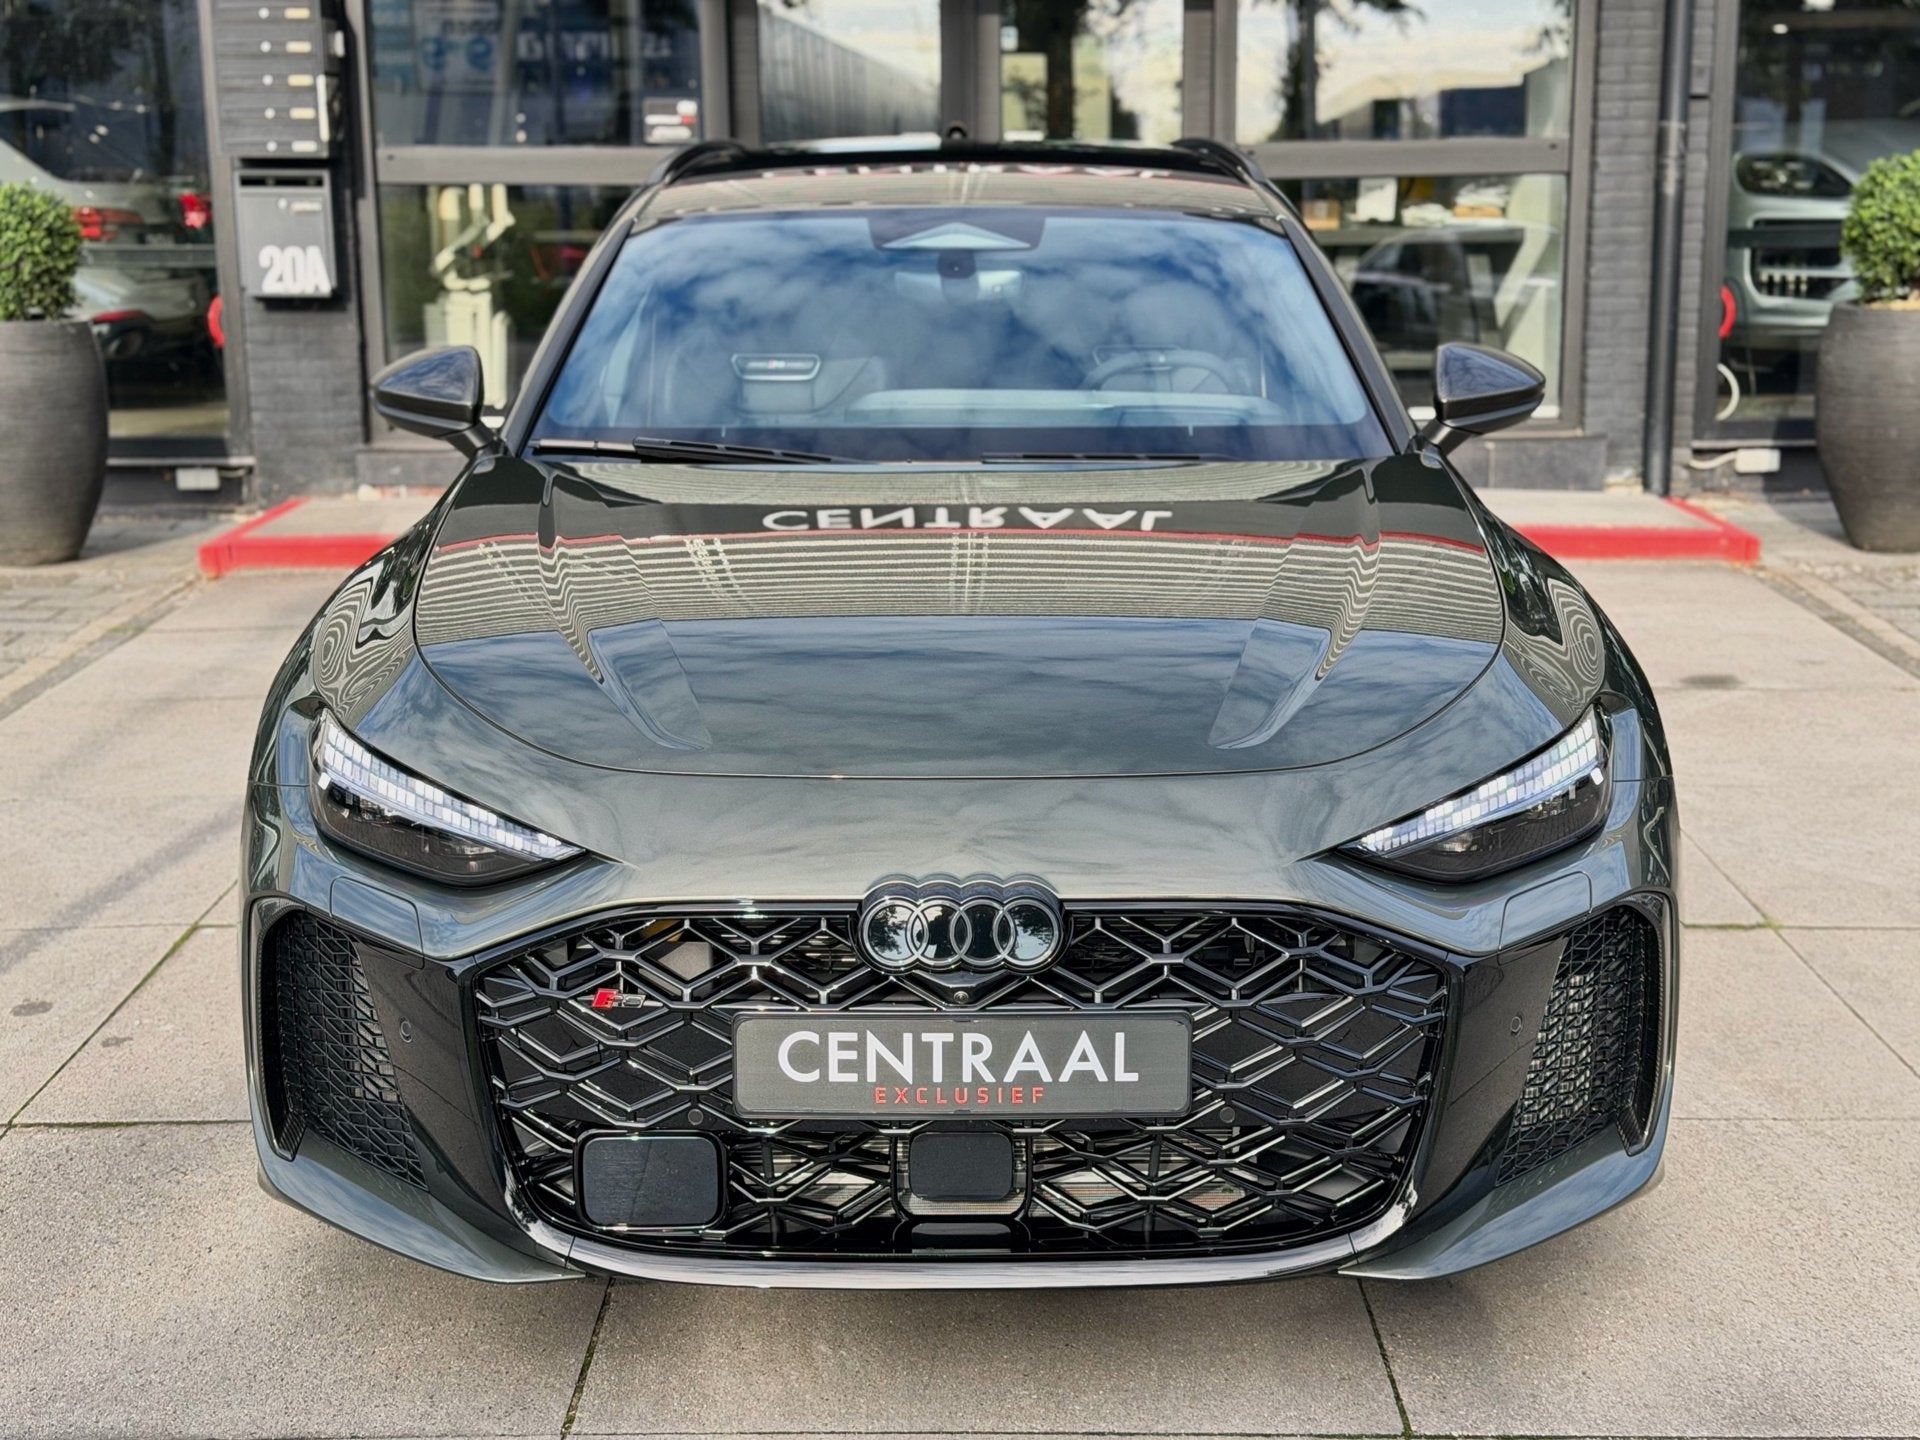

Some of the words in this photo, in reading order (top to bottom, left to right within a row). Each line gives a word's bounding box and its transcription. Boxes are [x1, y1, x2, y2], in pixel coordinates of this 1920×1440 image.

[257, 245, 332, 295] 20A
[778, 1030, 1139, 1084] CENTRAAL
[874, 1087, 1044, 1104] EXCLUSIEF
